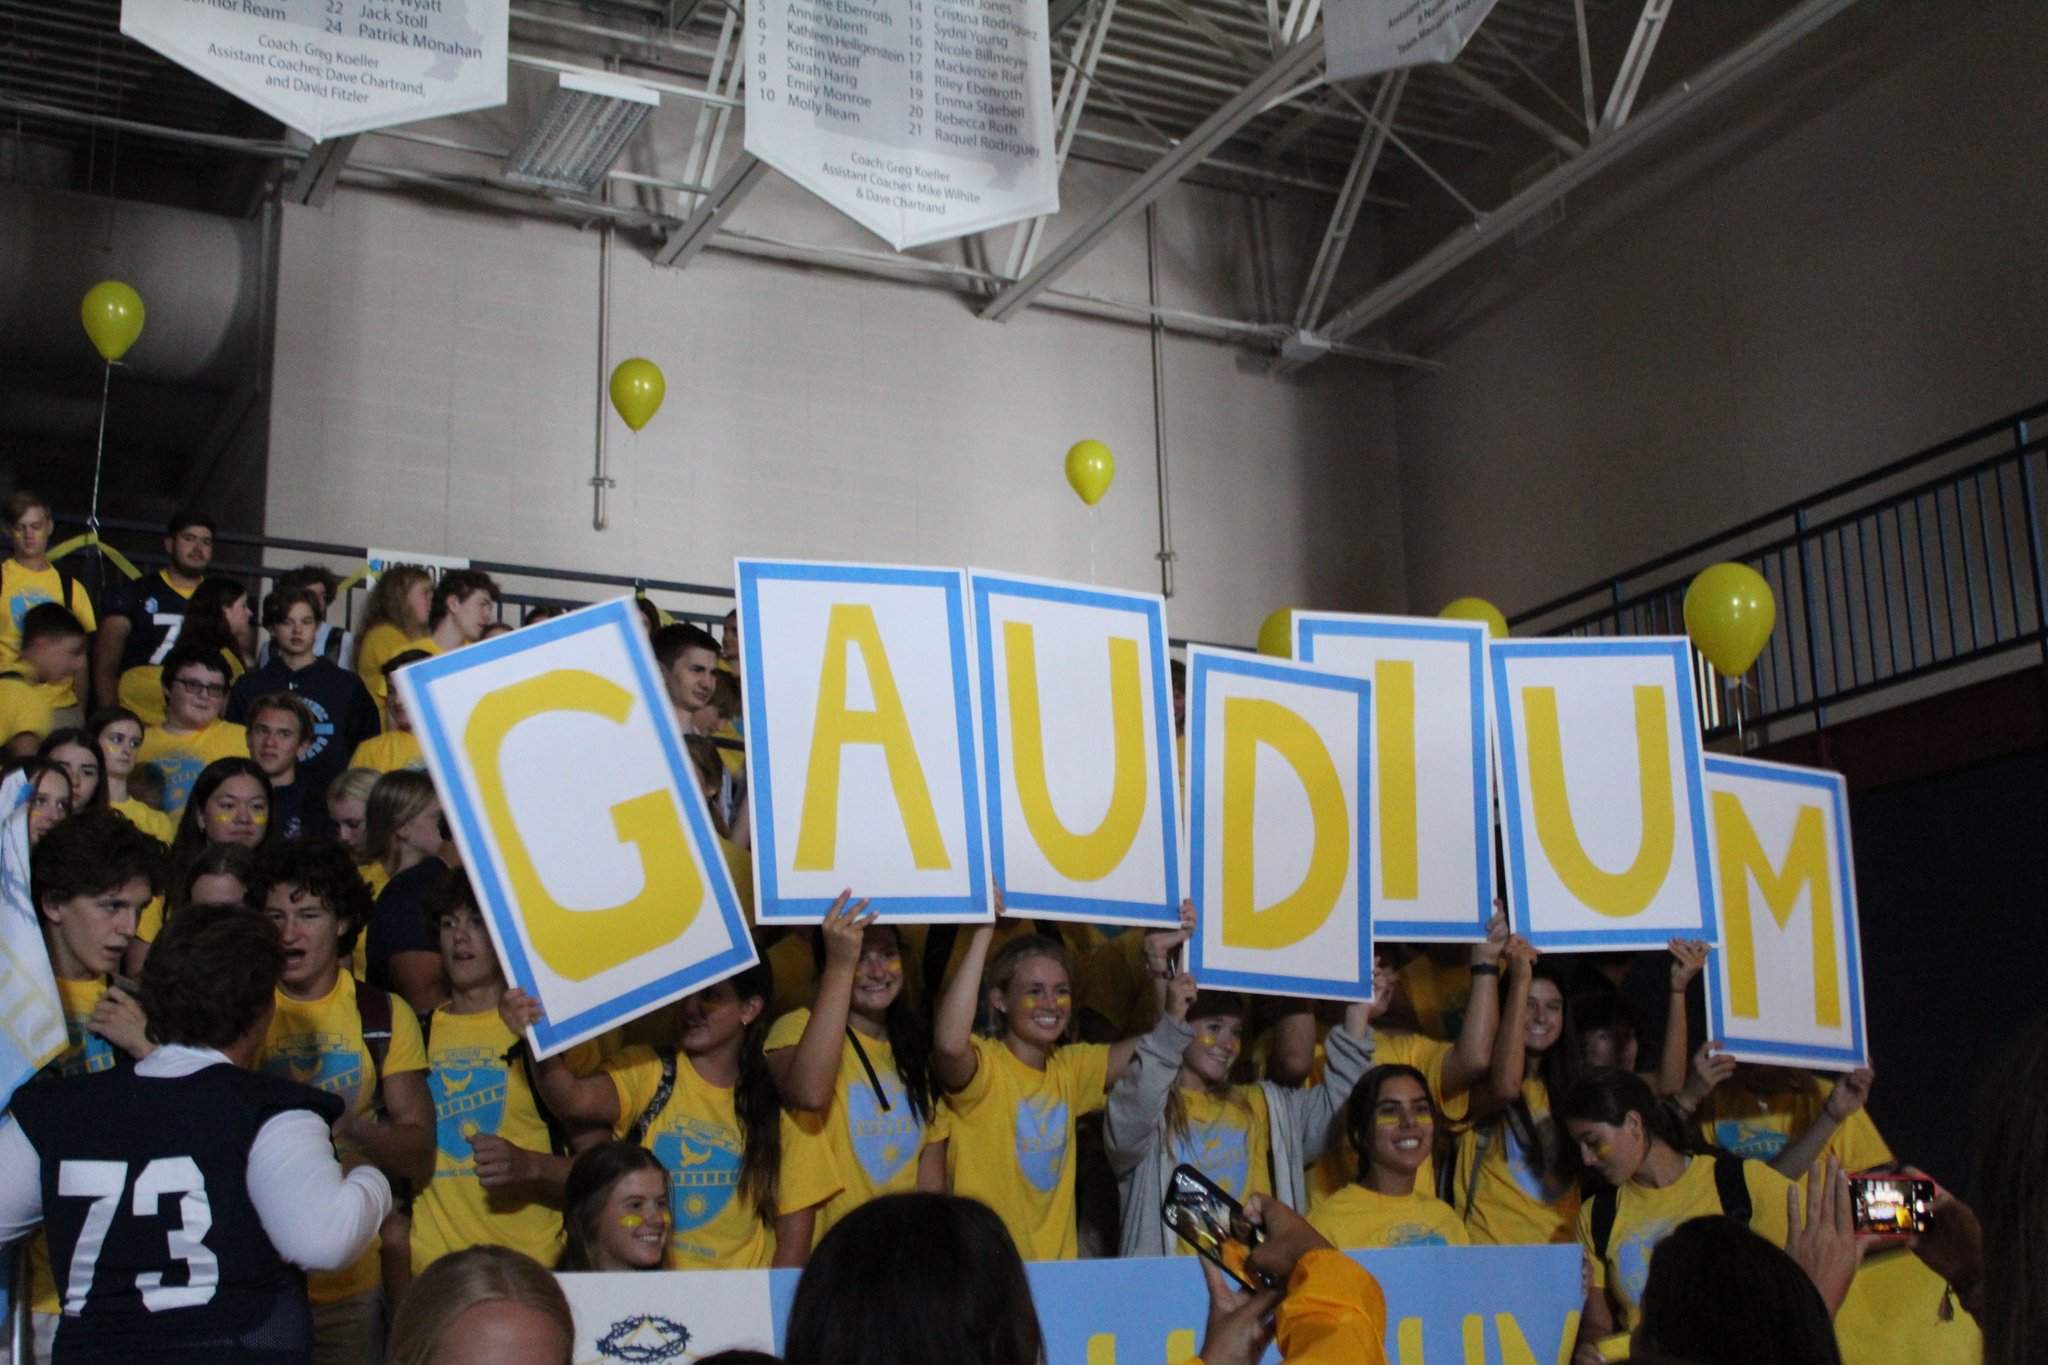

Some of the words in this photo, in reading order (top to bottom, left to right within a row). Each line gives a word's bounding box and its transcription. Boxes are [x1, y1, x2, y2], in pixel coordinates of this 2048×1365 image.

[242, 3, 286, 21] Ream
[326, 0, 343, 15] 22
[360, 4, 391, 22] Jack
[396, 11, 428, 29] Stoll
[787, 3, 823, 24] Annie
[824, 14, 868, 35] Valenti
[836, 0, 893, 26] Ebenroth
[909, 0, 922, 13] 14
[934, 5, 979, 26] Cristina
[982, 14, 1038, 41] Rodriguez
[978, 0, 1012, 15] Jones
[325, 17, 342, 34] 24
[359, 23, 408, 46] Patrick
[413, 32, 482, 59] Monahan
[758, 18, 766, 30] 6
[787, 21, 833, 46] Kathleen
[909, 17, 922, 30] 15
[934, 23, 967, 40] Sydni
[969, 30, 1008, 49] Young
[909, 34, 923, 49] 16
[934, 40, 972, 58] Nicole
[208, 42, 264, 66] Assistant
[326, 67, 357, 84] Dave
[304, 42, 332, 64] Greg
[336, 50, 379, 69] Koeller
[759, 34, 766, 47] 7
[787, 39, 825, 60] Kristin
[827, 51, 861, 68] Wolff
[909, 51, 922, 65] 17
[934, 58, 998, 80] Mackenzie
[265, 75, 290, 89] and
[293, 77, 327, 97] David
[758, 52, 766, 65] 8
[787, 56, 821, 78] Sarah
[825, 67, 858, 89] Harig
[909, 69, 923, 83] 18
[934, 75, 963, 95] Riley
[966, 81, 1023, 100] Ebenroth
[758, 70, 767, 83] 9
[787, 74, 820, 97] Emily
[823, 84, 872, 109] Monroe
[760, 87, 775, 103] 10
[788, 93, 822, 117] Molly
[825, 103, 860, 123] Ream
[909, 87, 923, 100] 19
[934, 92, 973, 111] Emma
[908, 104, 923, 119] 20
[934, 110, 986, 132] Rebecca
[988, 120, 1018, 136] Roth
[908, 123, 922, 136] 21
[934, 127, 977, 147] Raquel
[980, 136, 1040, 158] Rodriguez
[822, 161, 867, 184] Assistant
[917, 182, 941, 196] Mike
[886, 161, 912, 178] Greg
[915, 165, 951, 182] Koeller
[855, 187, 864, 199] &
[865, 189, 891, 205] Dave
[893, 197, 946, 215] Chartrand
[57, 1155, 220, 1318] 73
